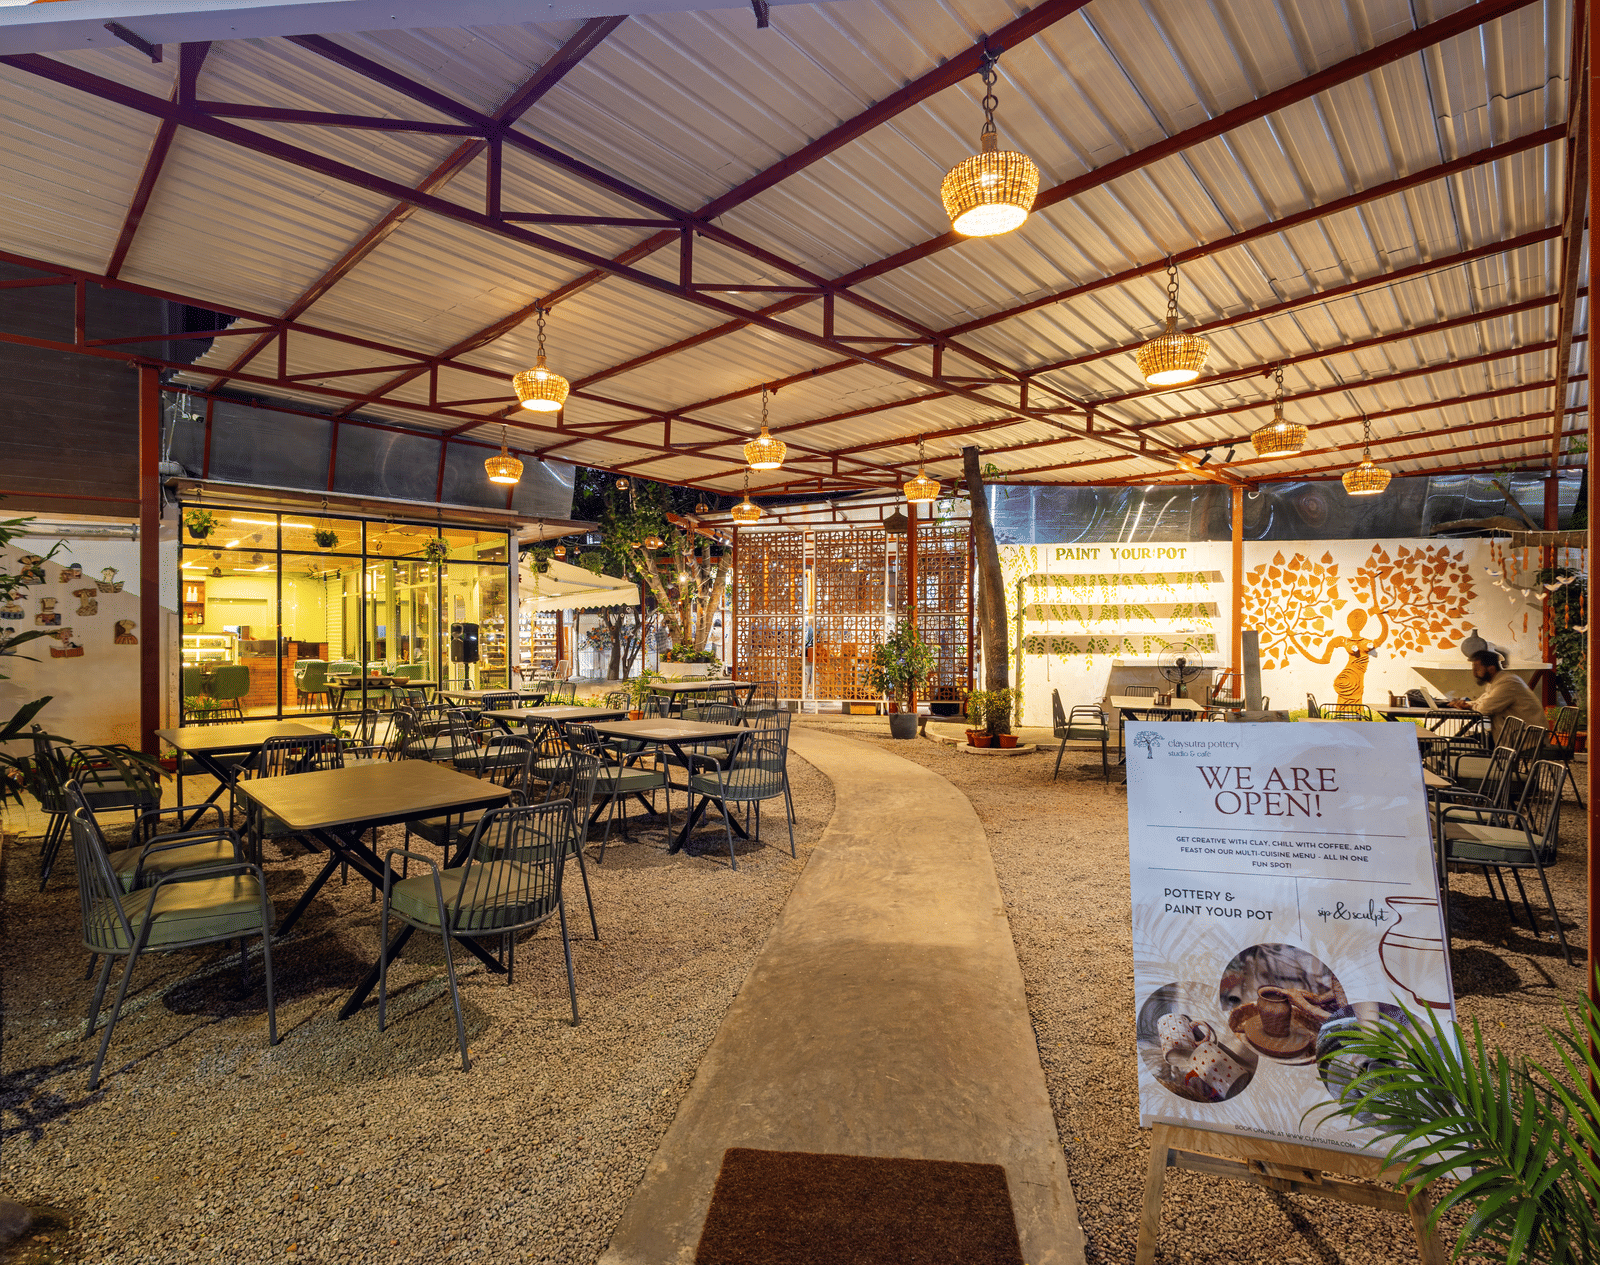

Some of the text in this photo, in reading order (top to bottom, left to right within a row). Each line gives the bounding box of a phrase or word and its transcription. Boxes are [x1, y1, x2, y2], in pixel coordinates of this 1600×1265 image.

[1056, 547, 1187, 561] PAINT YOUR POT
[1167, 739, 1240, 750] claysutra pottery
[1196, 765, 1340, 792] WE ARE
[1214, 790, 1322, 817] OPEN!
[1235, 850, 1290, 858] MULTI-CUISINE
[1164, 888, 1235, 902] POTTERY &
[1165, 904, 1273, 921] PAINT YOUR POT
[1235, 1124, 1252, 1132] BOOK
[1253, 1128, 1276, 1136] ONLINE
